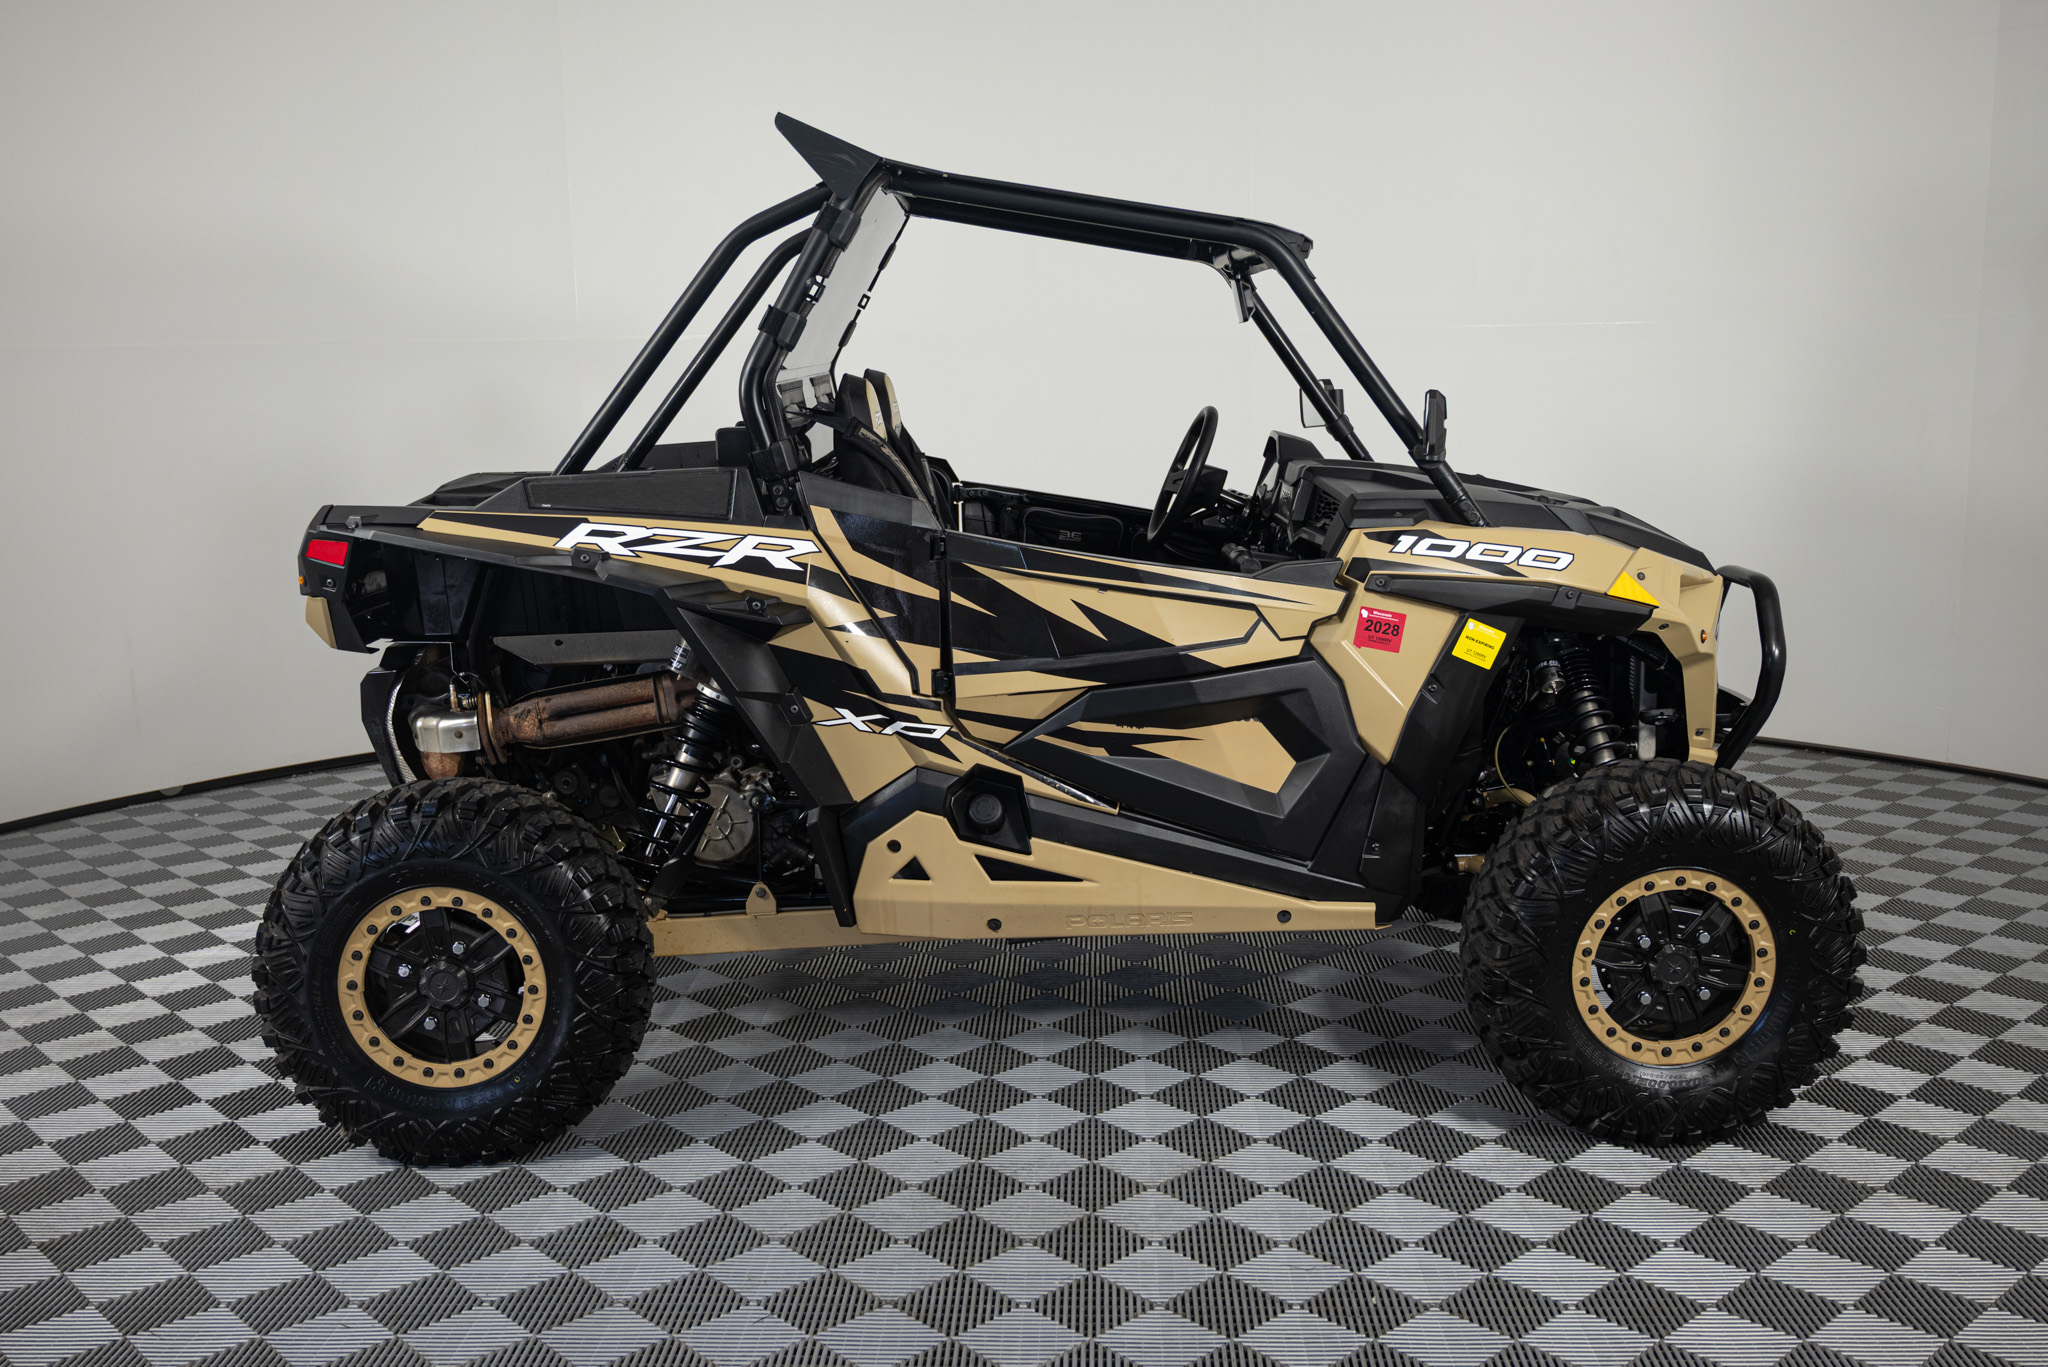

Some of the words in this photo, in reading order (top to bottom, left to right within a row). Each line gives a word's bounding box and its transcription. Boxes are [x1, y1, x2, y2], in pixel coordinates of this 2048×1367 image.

[552, 522, 821, 572] RZR
[1389, 534, 1575, 571] 1000
[1363, 619, 1400, 637] 2028
[814, 706, 953, 741] XP
[1065, 911, 1194, 930] POLARIS
